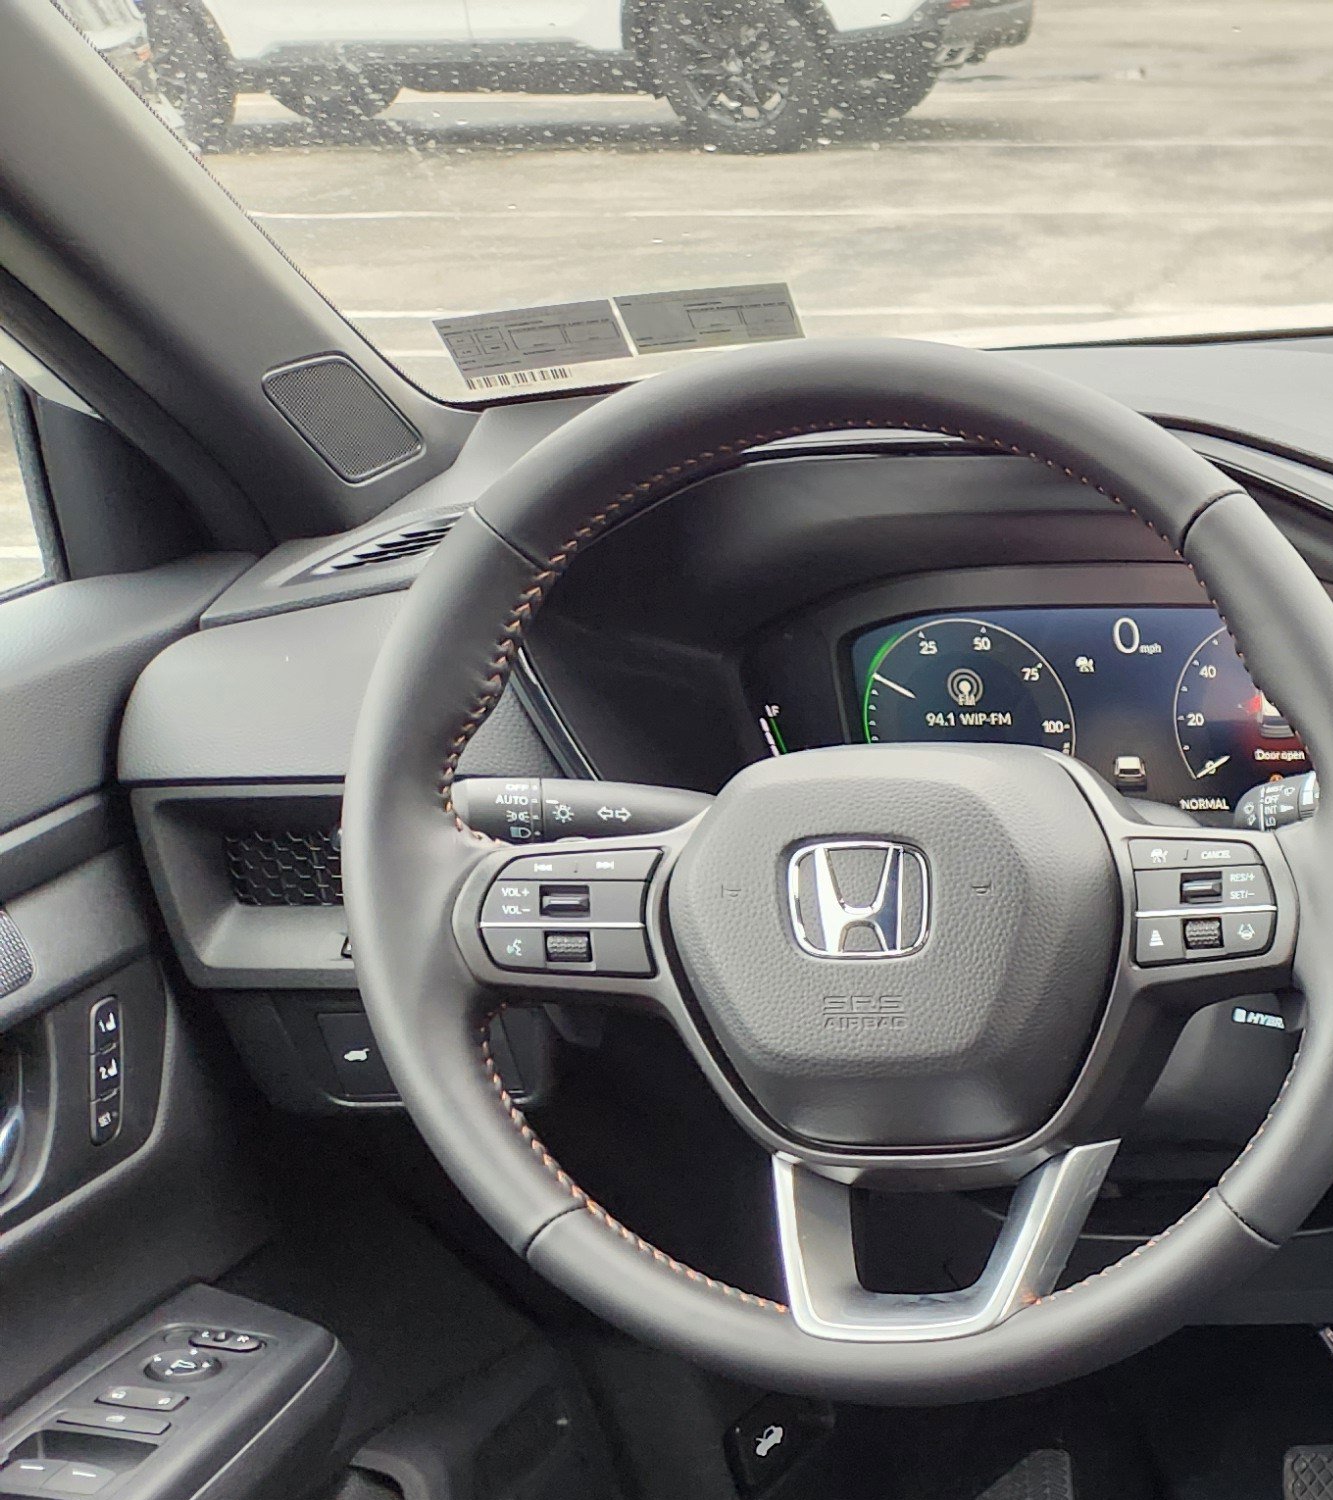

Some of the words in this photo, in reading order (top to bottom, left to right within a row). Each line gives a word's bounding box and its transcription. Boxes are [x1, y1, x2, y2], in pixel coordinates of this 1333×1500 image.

[1113, 617, 1140, 654] 0
[1140, 643, 1162, 655] mph
[919, 641, 938, 655] 25
[973, 637, 991, 651] 50
[1021, 668, 1040, 681] 75
[1199, 666, 1217, 678] 40
[926, 713, 956, 727] 94.1
[960, 712, 1012, 727] WIP-FM
[1187, 714, 1204, 727] 20
[1042, 721, 1064, 734] 100
[1254, 749, 1280, 761] Door
[1281, 750, 1306, 762] open
[495, 794, 529, 806] AUTO
[1180, 798, 1230, 811] NORMAL
[1264, 806, 1278, 815] INT
[1200, 850, 1231, 860] CANCEL
